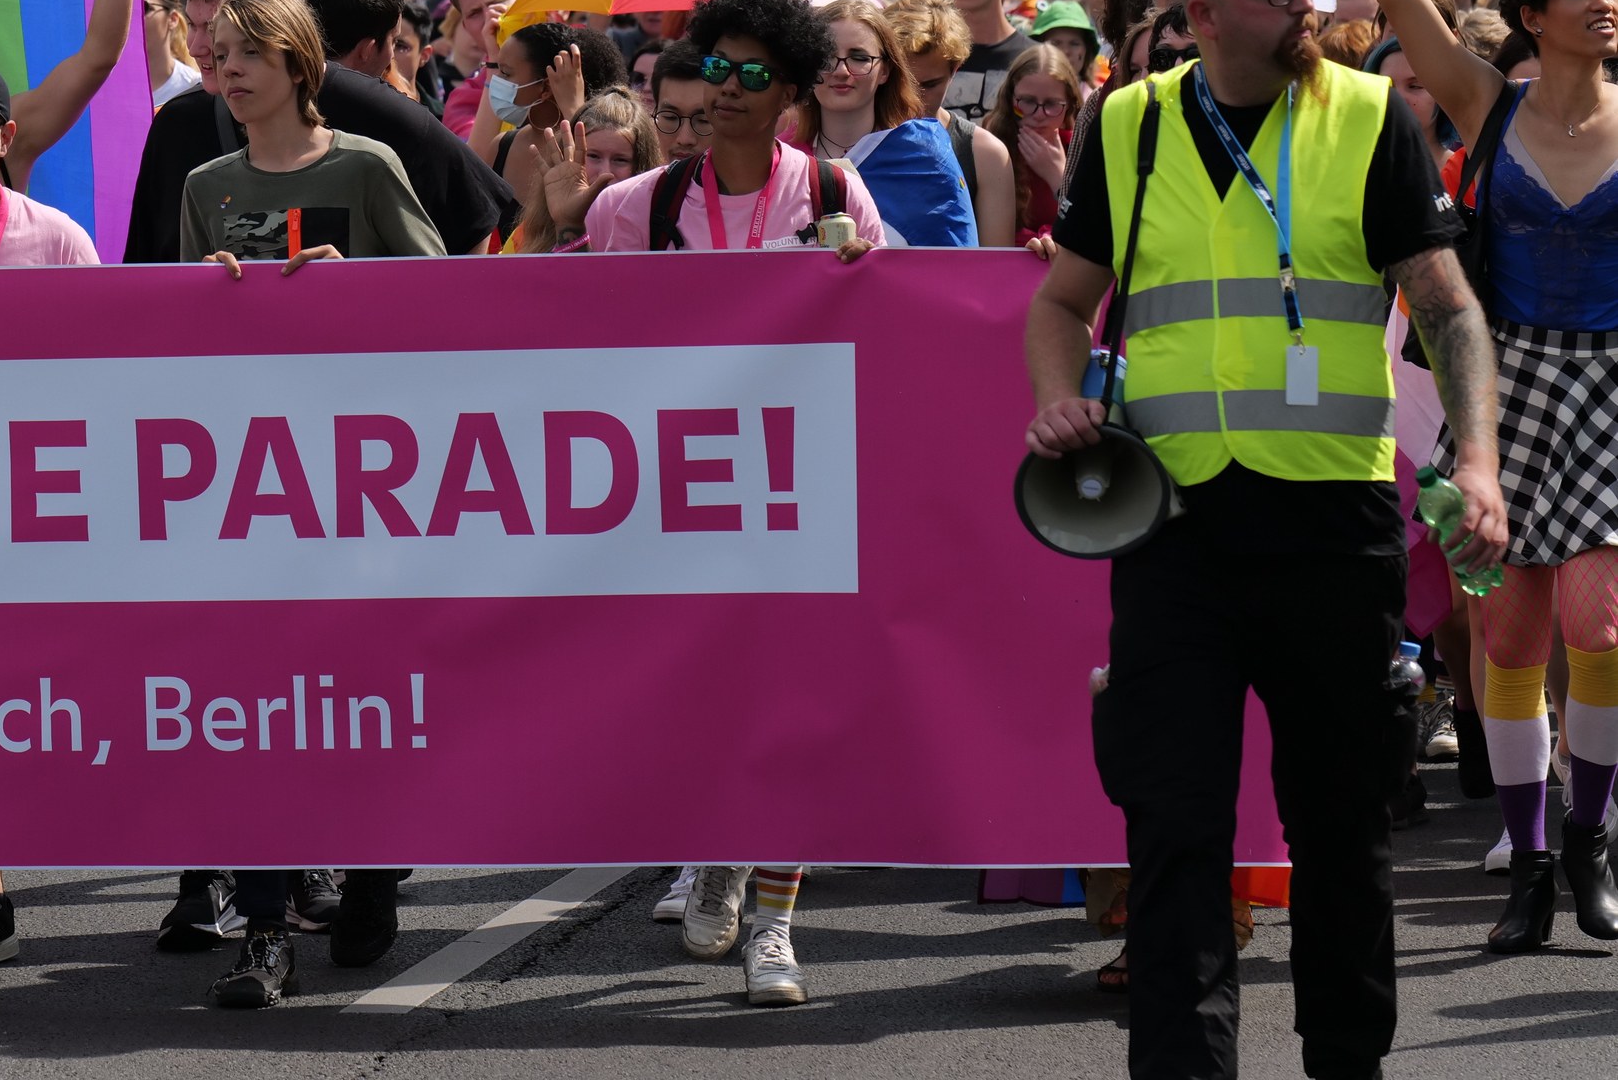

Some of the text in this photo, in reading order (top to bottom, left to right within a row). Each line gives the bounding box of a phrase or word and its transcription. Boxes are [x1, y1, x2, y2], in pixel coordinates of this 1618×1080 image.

[764, 237, 817, 249] VOLUNTR
[135, 407, 799, 541] PARADE!
[144, 673, 427, 752] Berlin!
